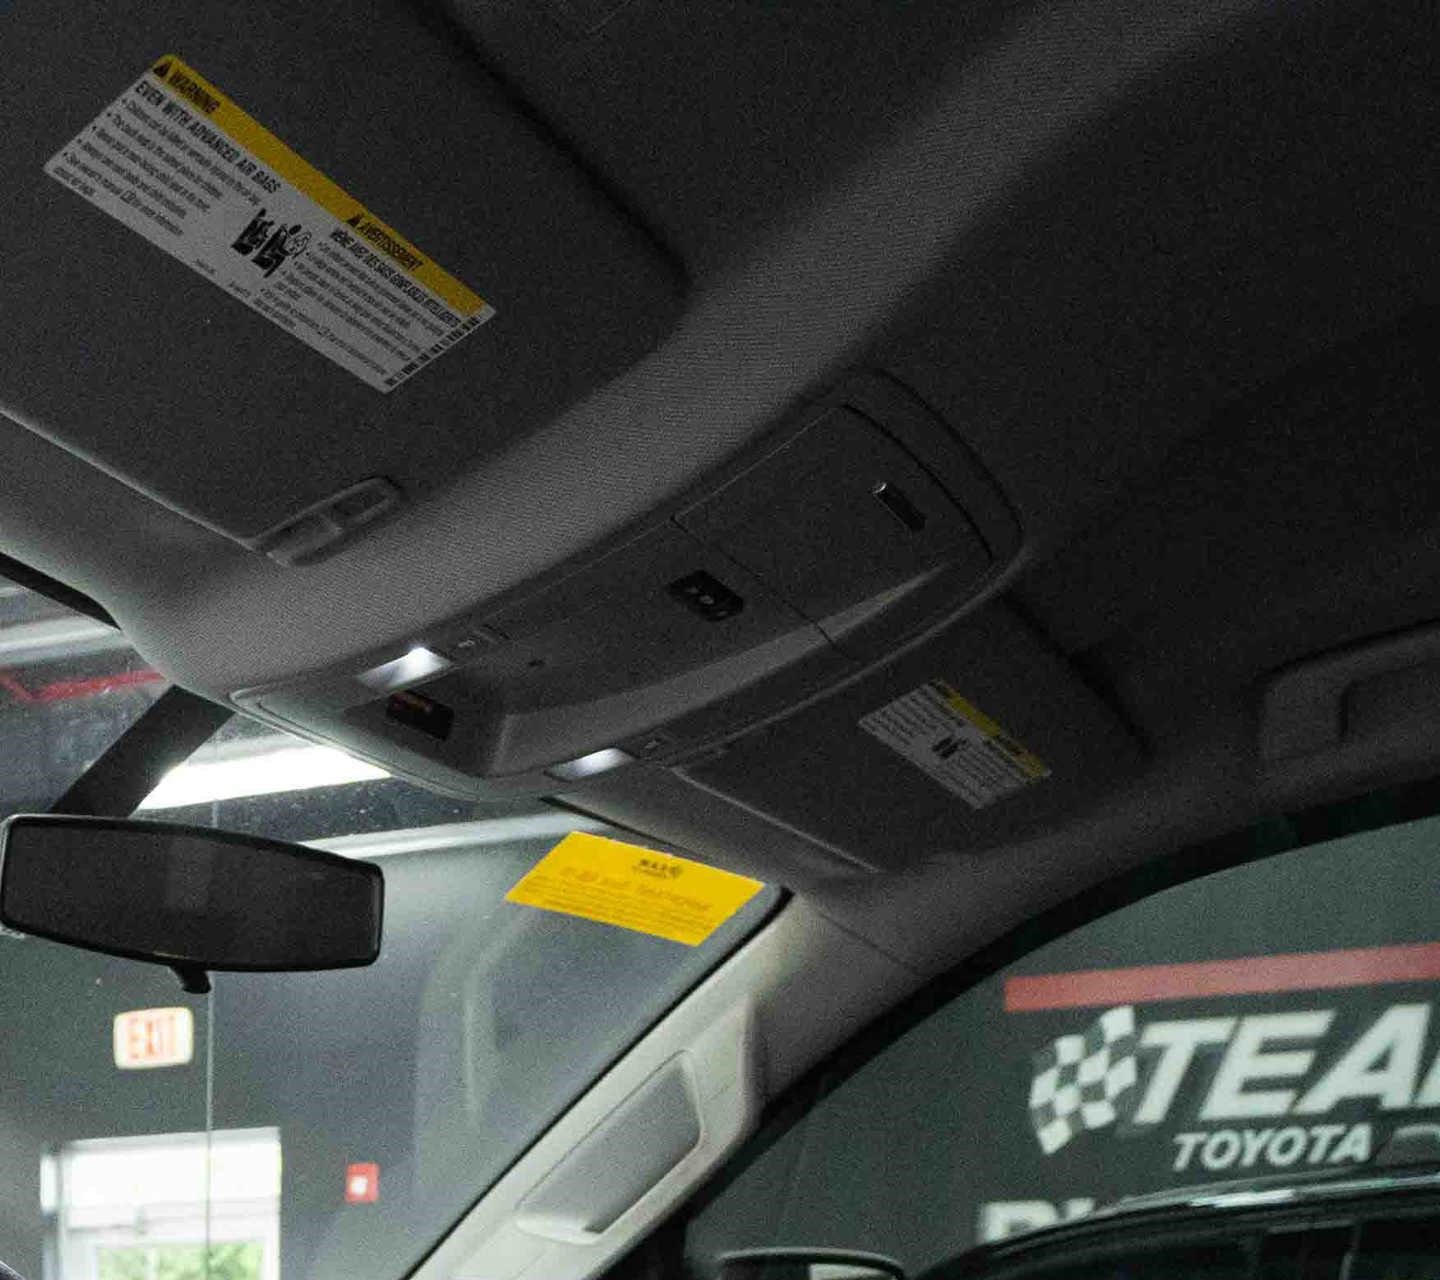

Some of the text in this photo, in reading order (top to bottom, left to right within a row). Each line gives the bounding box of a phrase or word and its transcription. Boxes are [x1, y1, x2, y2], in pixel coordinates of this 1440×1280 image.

[134, 81, 282, 194] EVEN WITH ADVANCED AIR BAGS
[1172, 1122, 1370, 1171] TOYOTA
